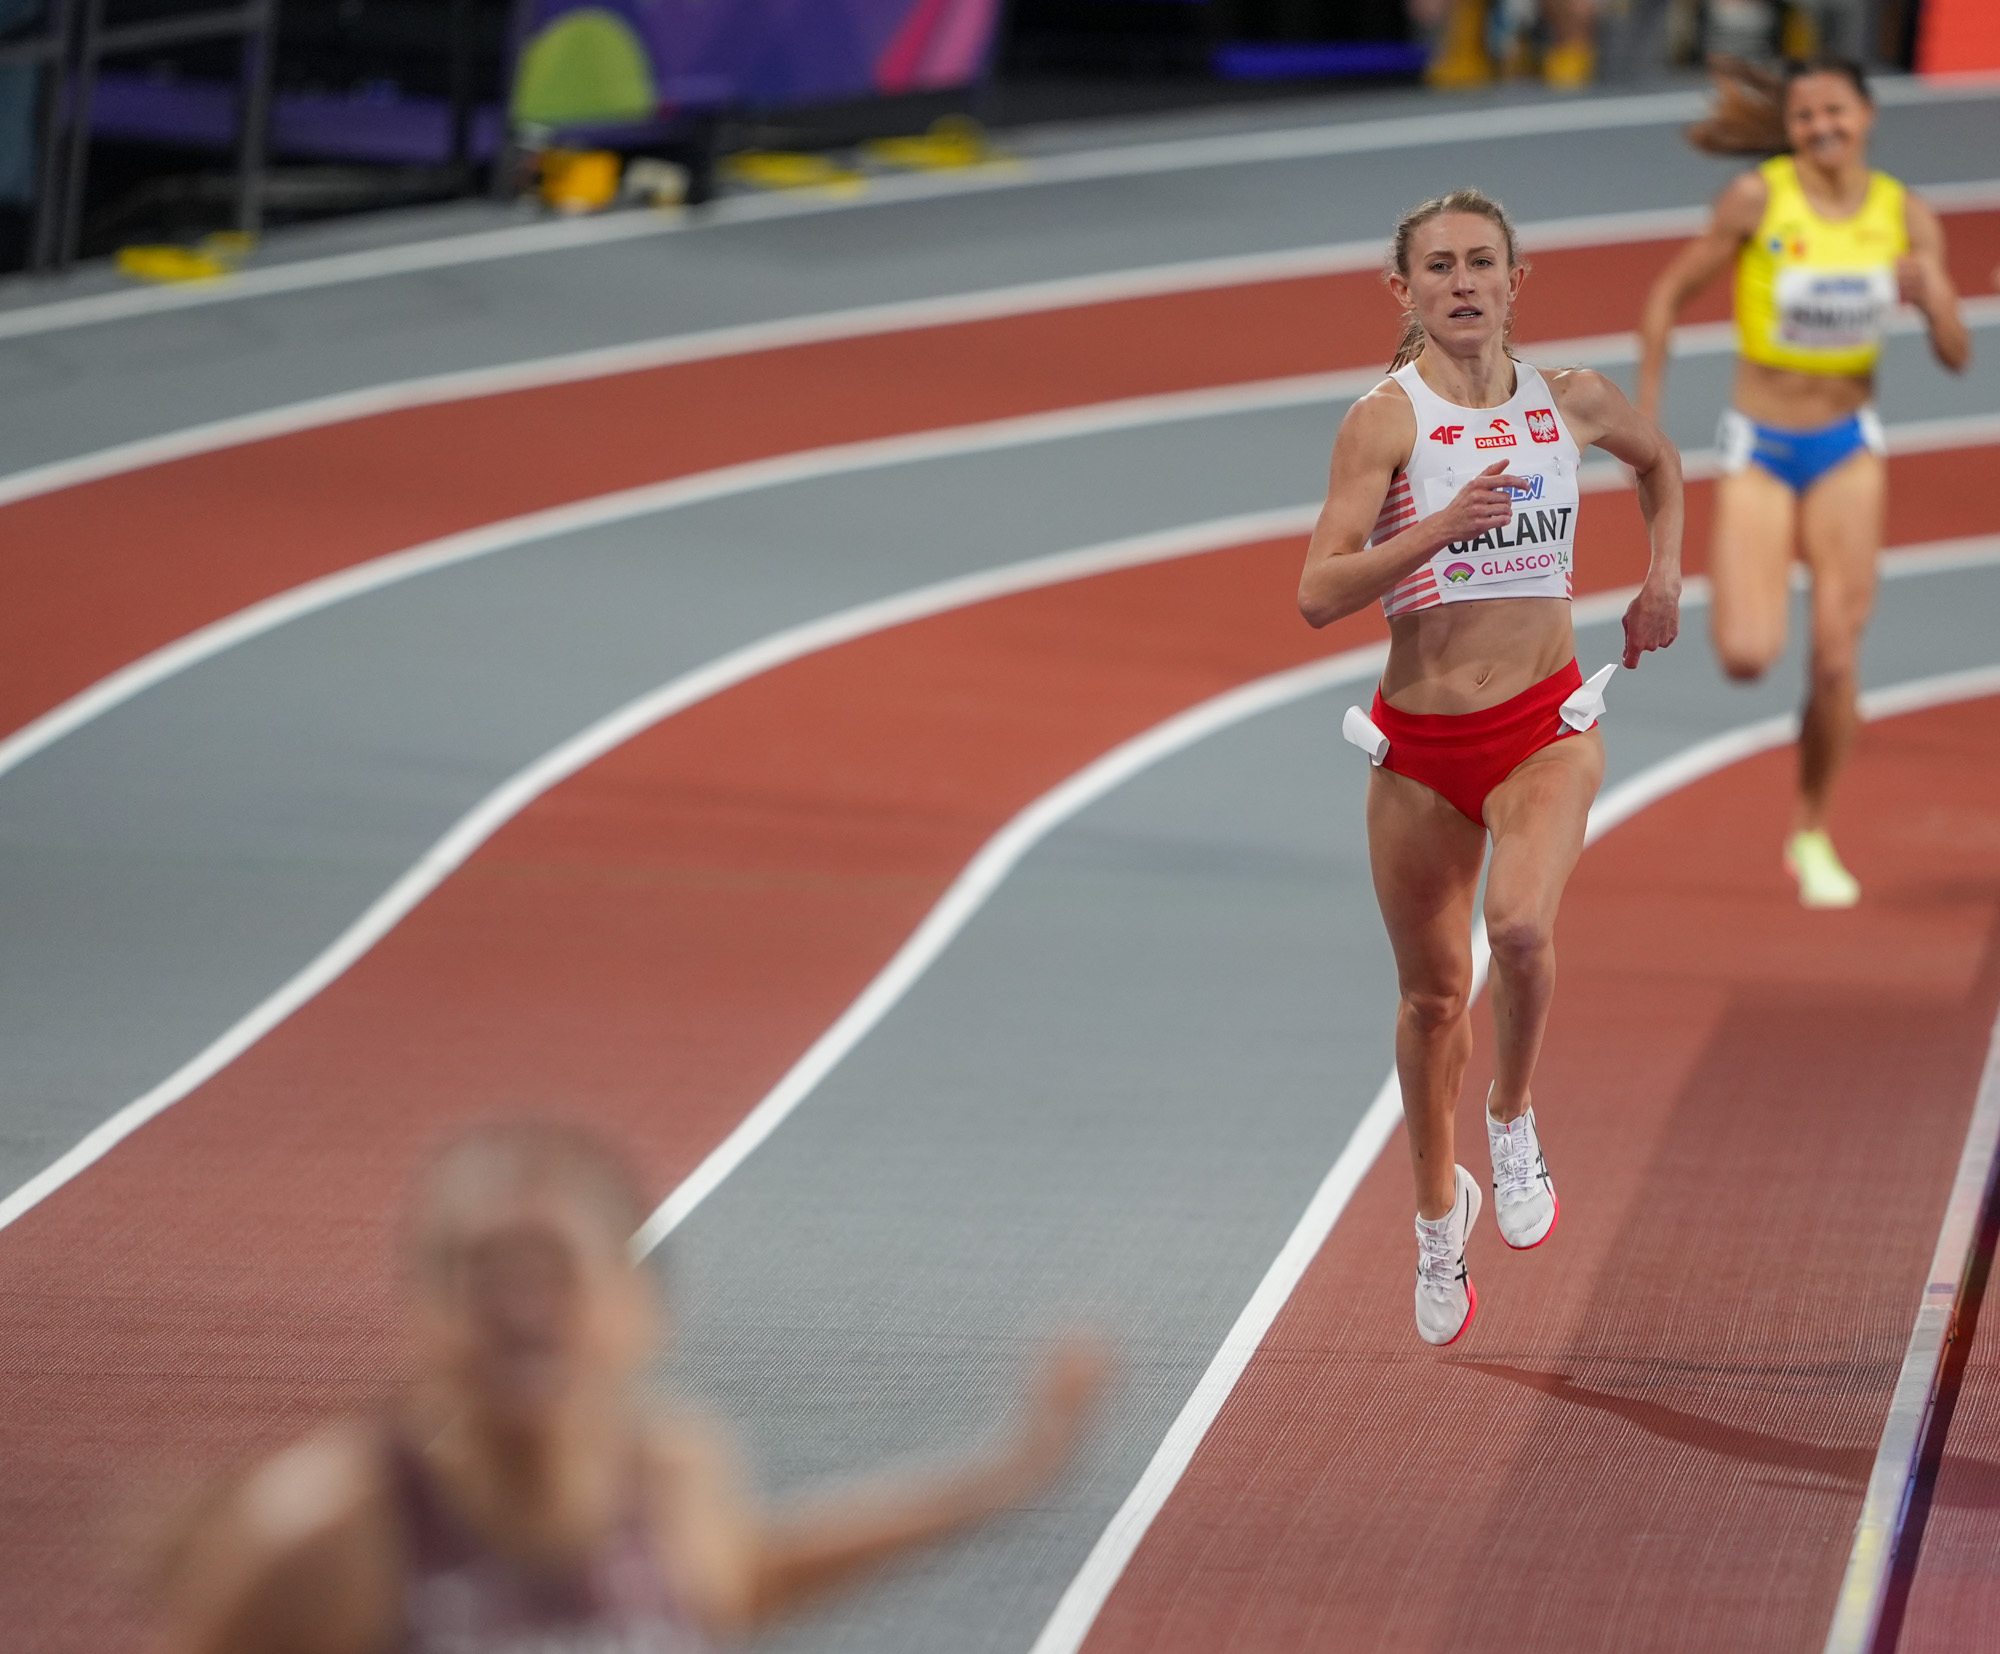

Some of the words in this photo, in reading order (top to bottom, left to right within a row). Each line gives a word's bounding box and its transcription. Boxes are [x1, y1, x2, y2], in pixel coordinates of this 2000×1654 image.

[1429, 425, 1465, 445] 4F
[1476, 435, 1515, 448] ORLEN
[1557, 551, 1569, 565] 24
